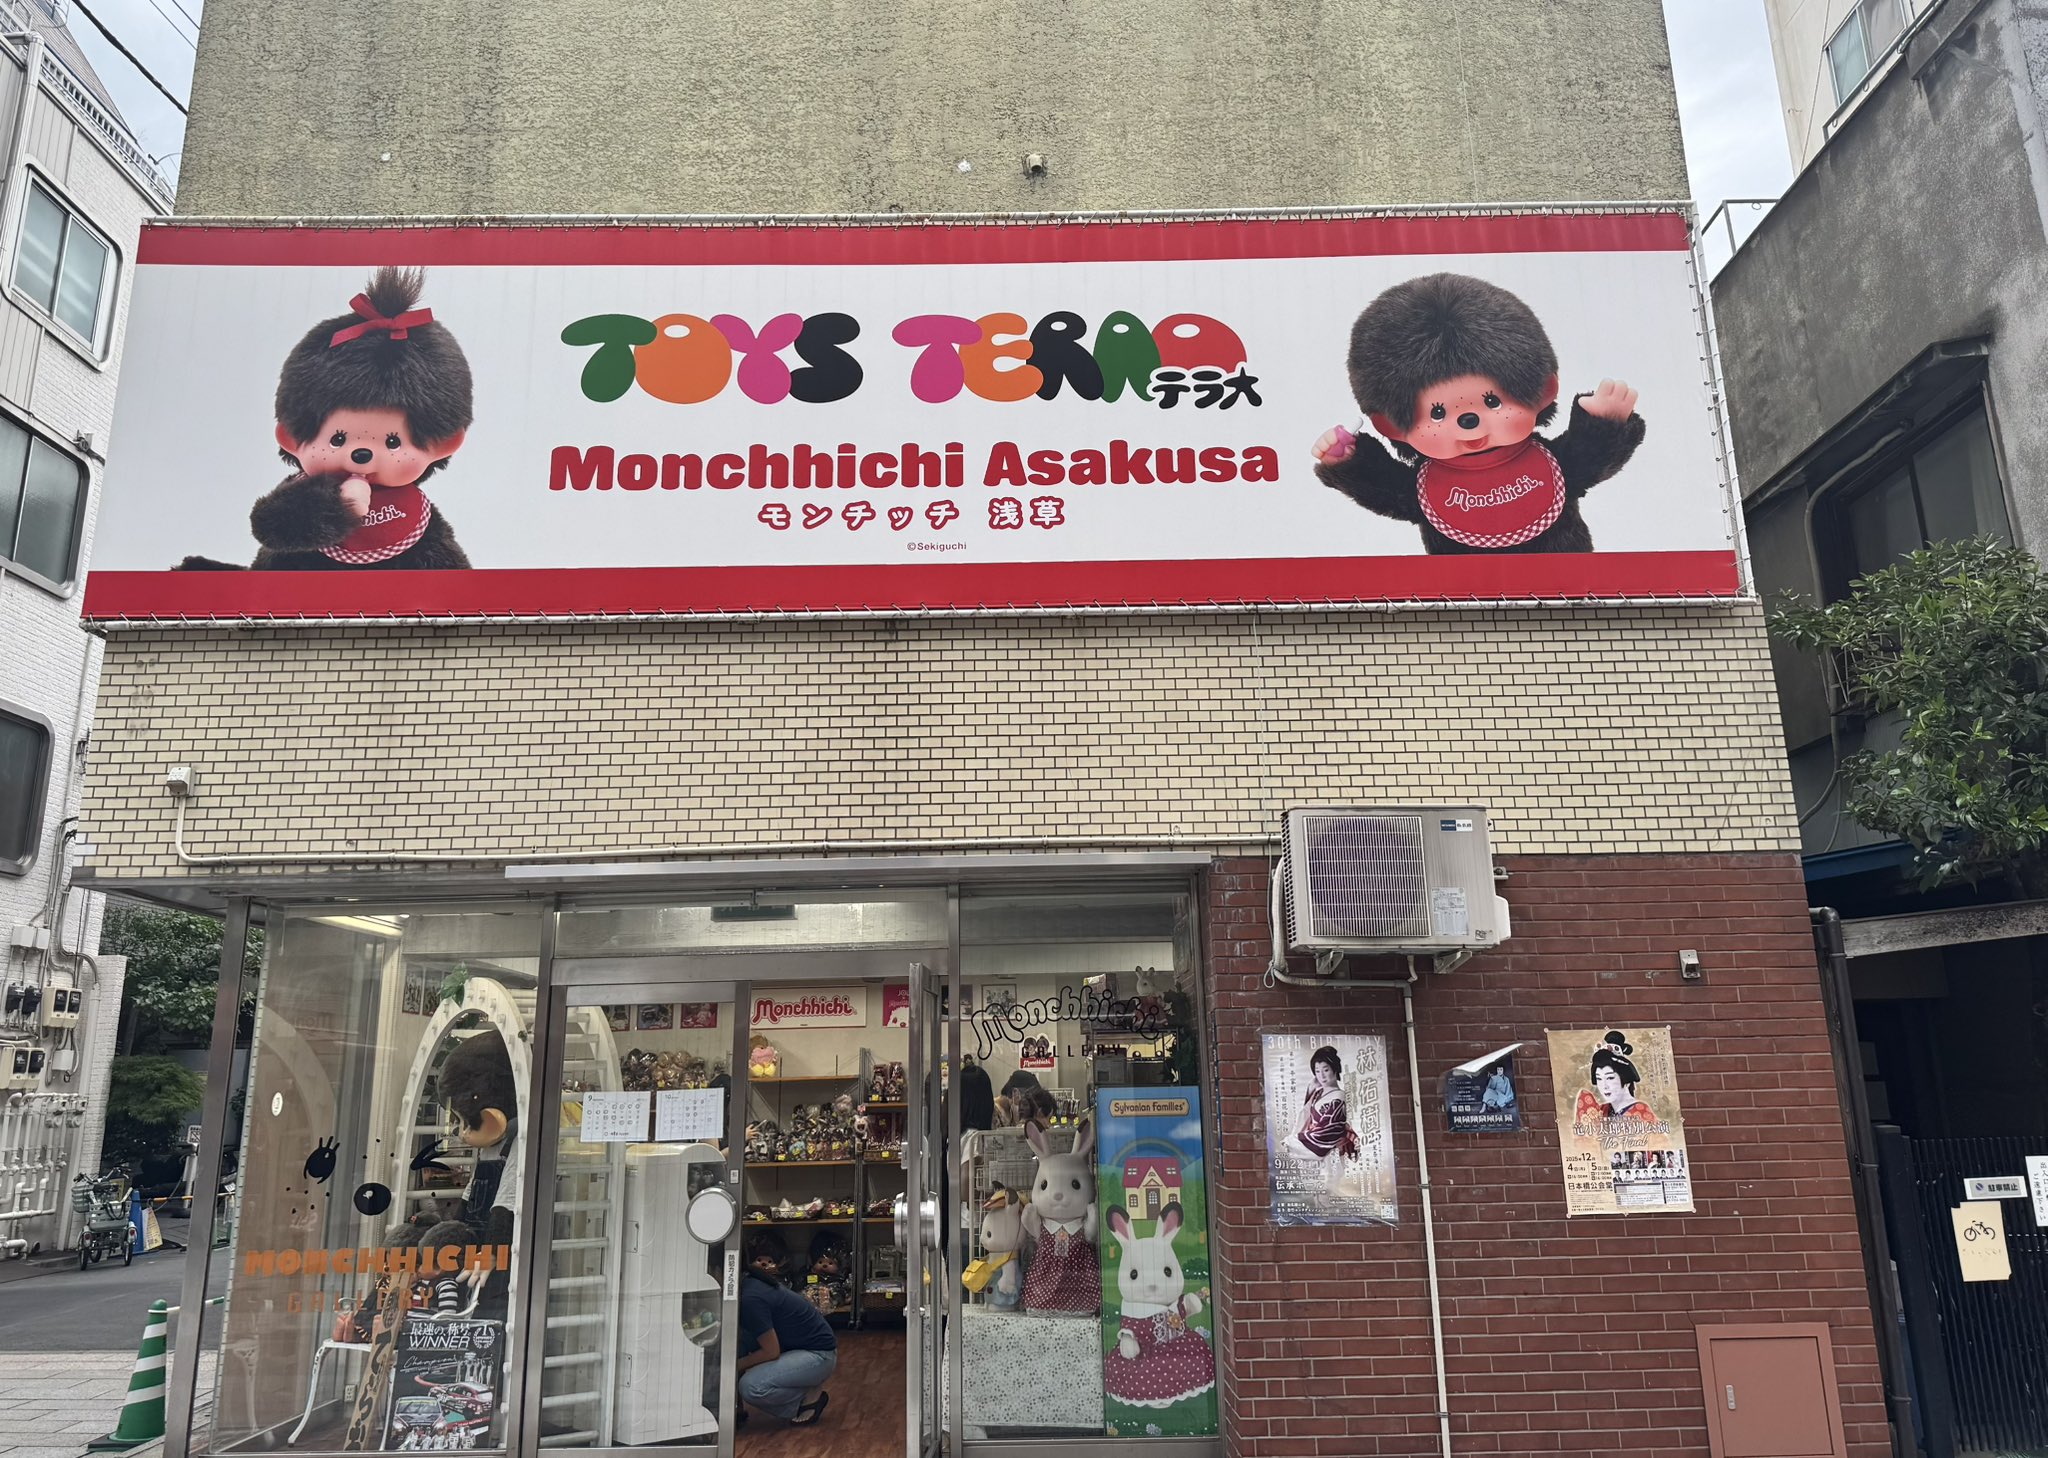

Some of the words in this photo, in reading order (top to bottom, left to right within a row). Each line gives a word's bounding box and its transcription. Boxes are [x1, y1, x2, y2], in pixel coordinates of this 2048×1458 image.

[560, 312, 864, 404] TOYS
[549, 442, 964, 491] Monchhichi
[982, 439, 1280, 487] Asakusa
[757, 499, 960, 532] モンチッチ
[987, 496, 1066, 531] 浅草
[750, 994, 854, 1025] Monchhichi
[971, 985, 1160, 1060] Monchhichi
[1113, 1101, 1151, 1114] Sylvanian
[1152, 1101, 1184, 1112] Families
[1987, 1183, 2019, 1192] 駐車禁止
[243, 1244, 509, 1277] MONCHHICHI
[410, 1335, 471, 1348] WINNER
